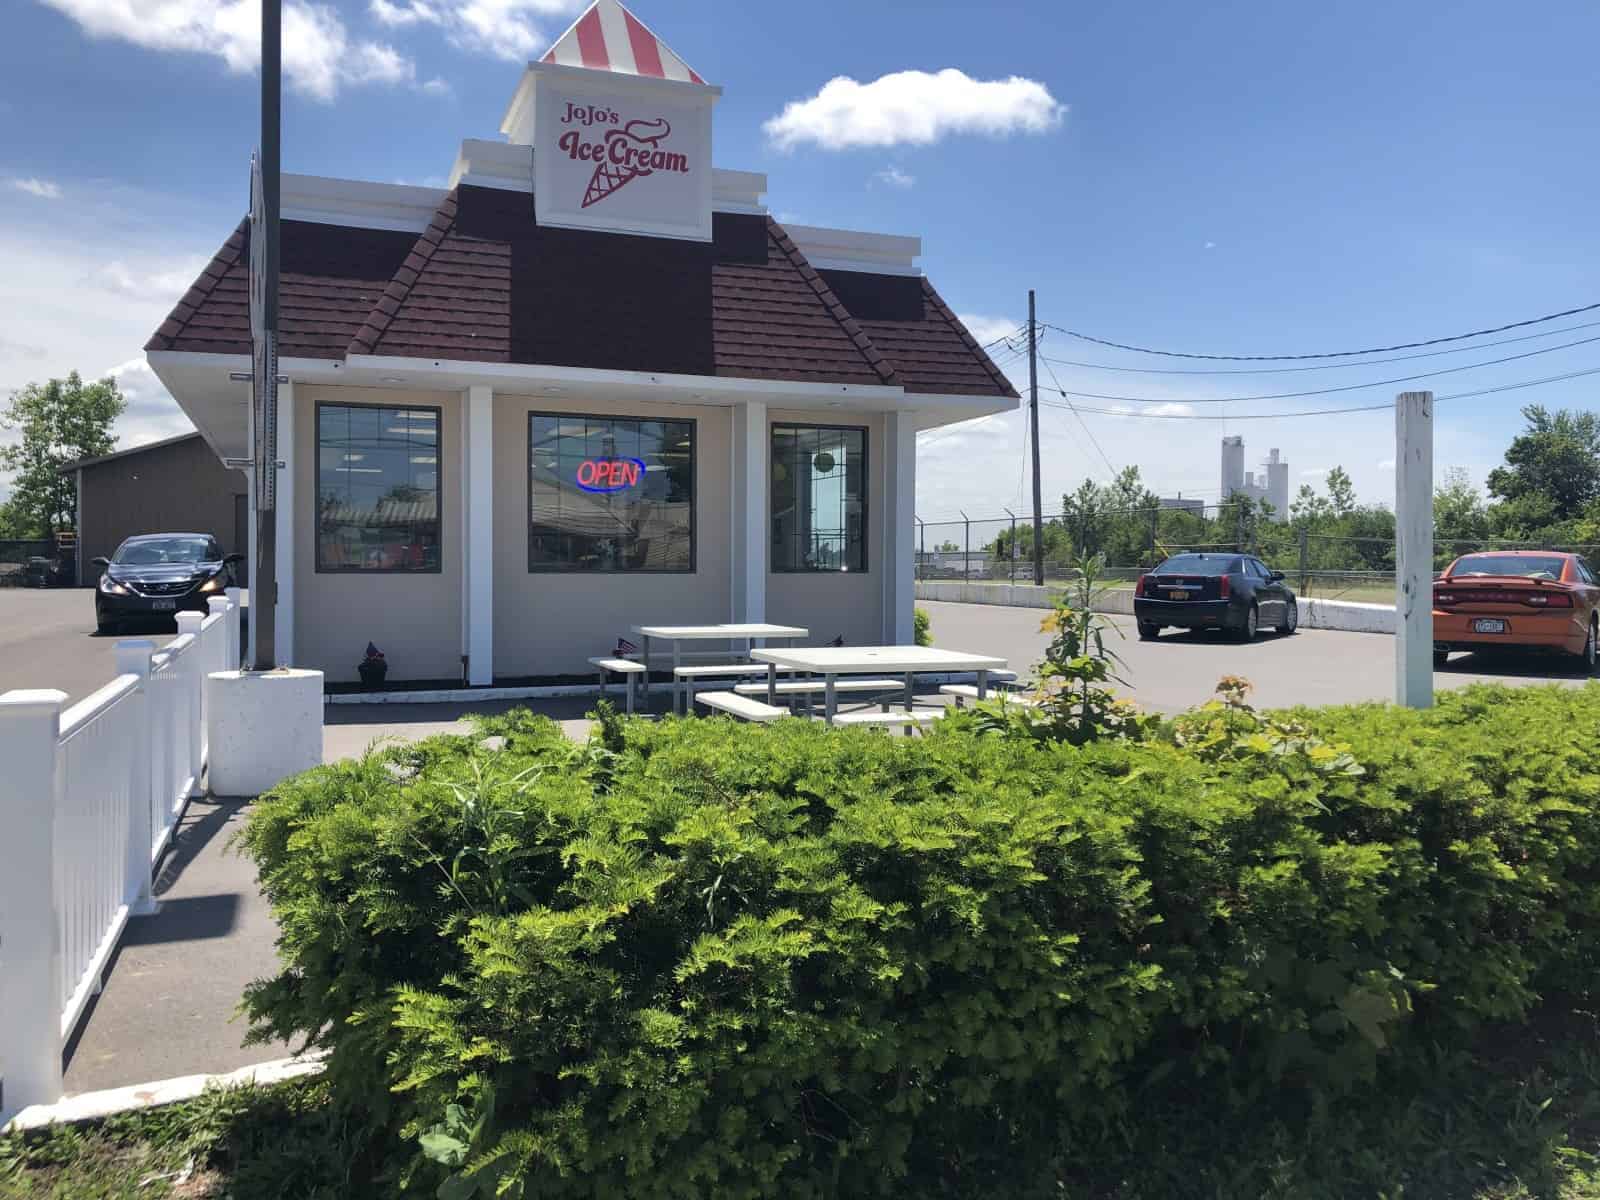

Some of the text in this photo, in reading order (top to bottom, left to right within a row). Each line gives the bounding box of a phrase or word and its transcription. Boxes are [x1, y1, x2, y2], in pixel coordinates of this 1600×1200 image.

[561, 102, 619, 126] JoJo's
[559, 131, 689, 172] Ice Cream
[577, 461, 639, 487] OPEN
